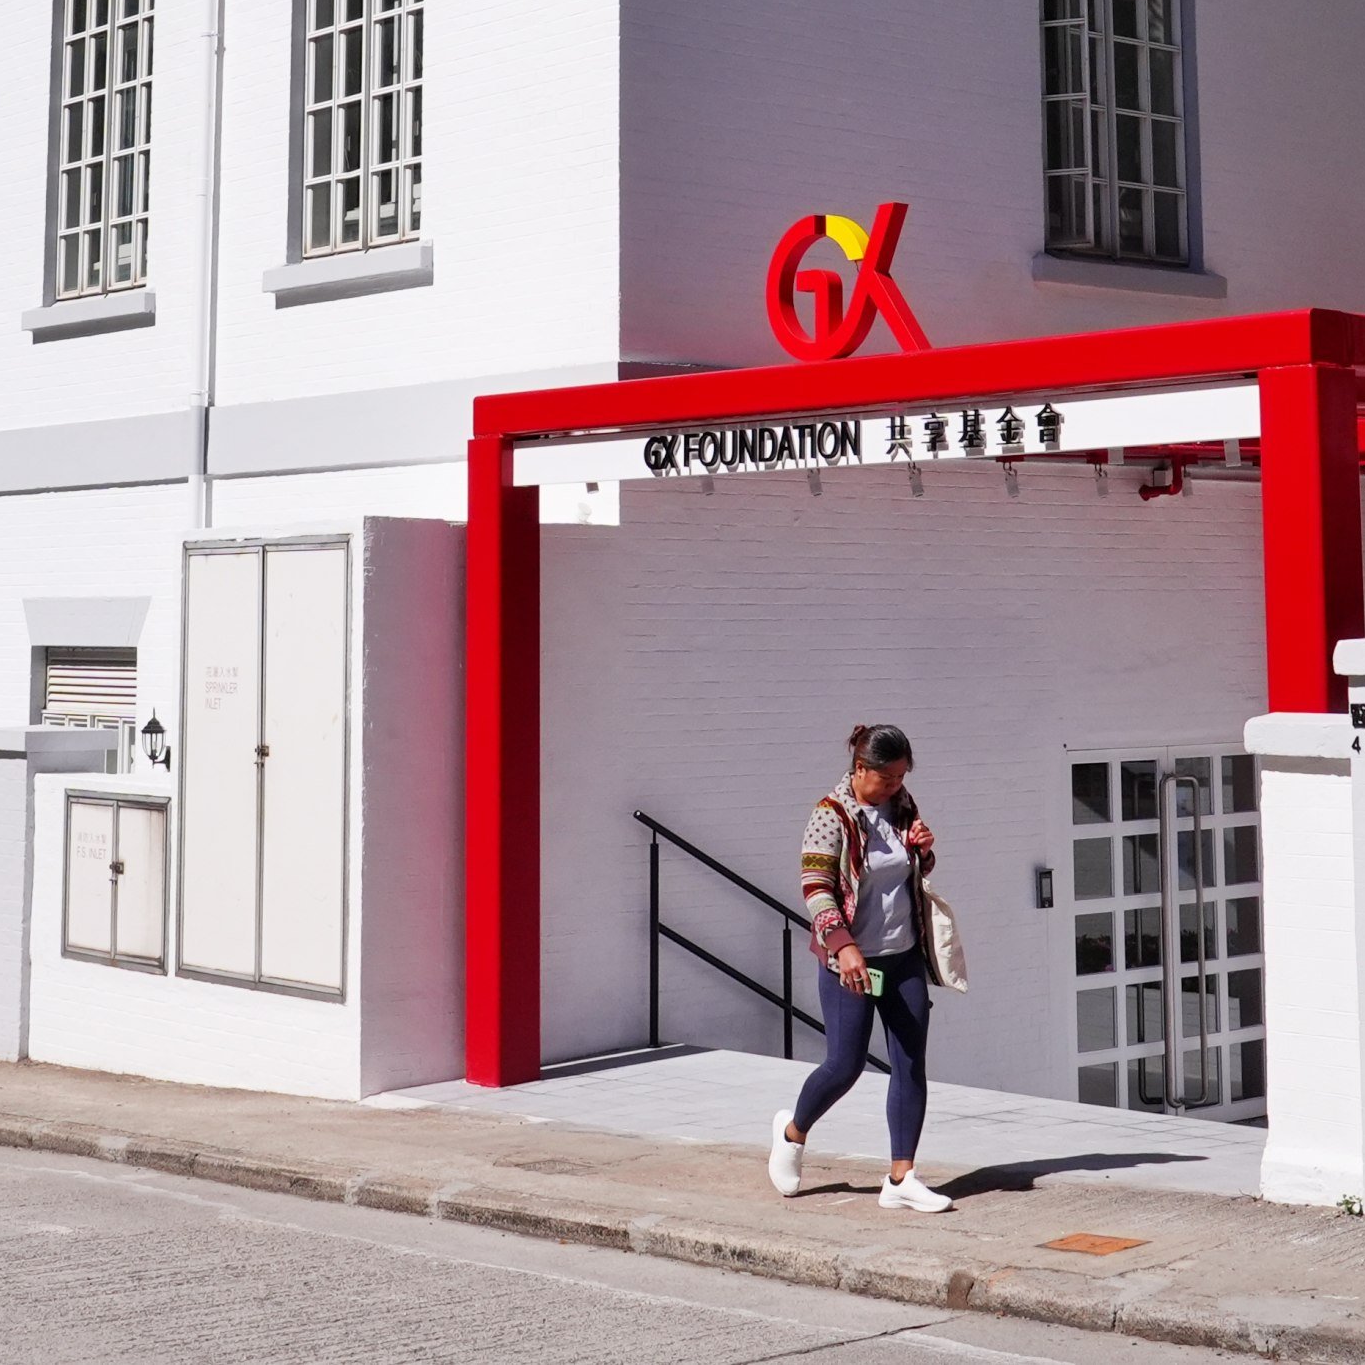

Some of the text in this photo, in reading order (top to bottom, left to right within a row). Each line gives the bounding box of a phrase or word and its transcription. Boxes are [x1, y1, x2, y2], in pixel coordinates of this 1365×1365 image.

[766, 202, 932, 362] GX
[644, 403, 1065, 472] GX FOUNDATION 共享基金會
[205, 697, 222, 709] INLET
[1351, 736, 1361, 754] 4
